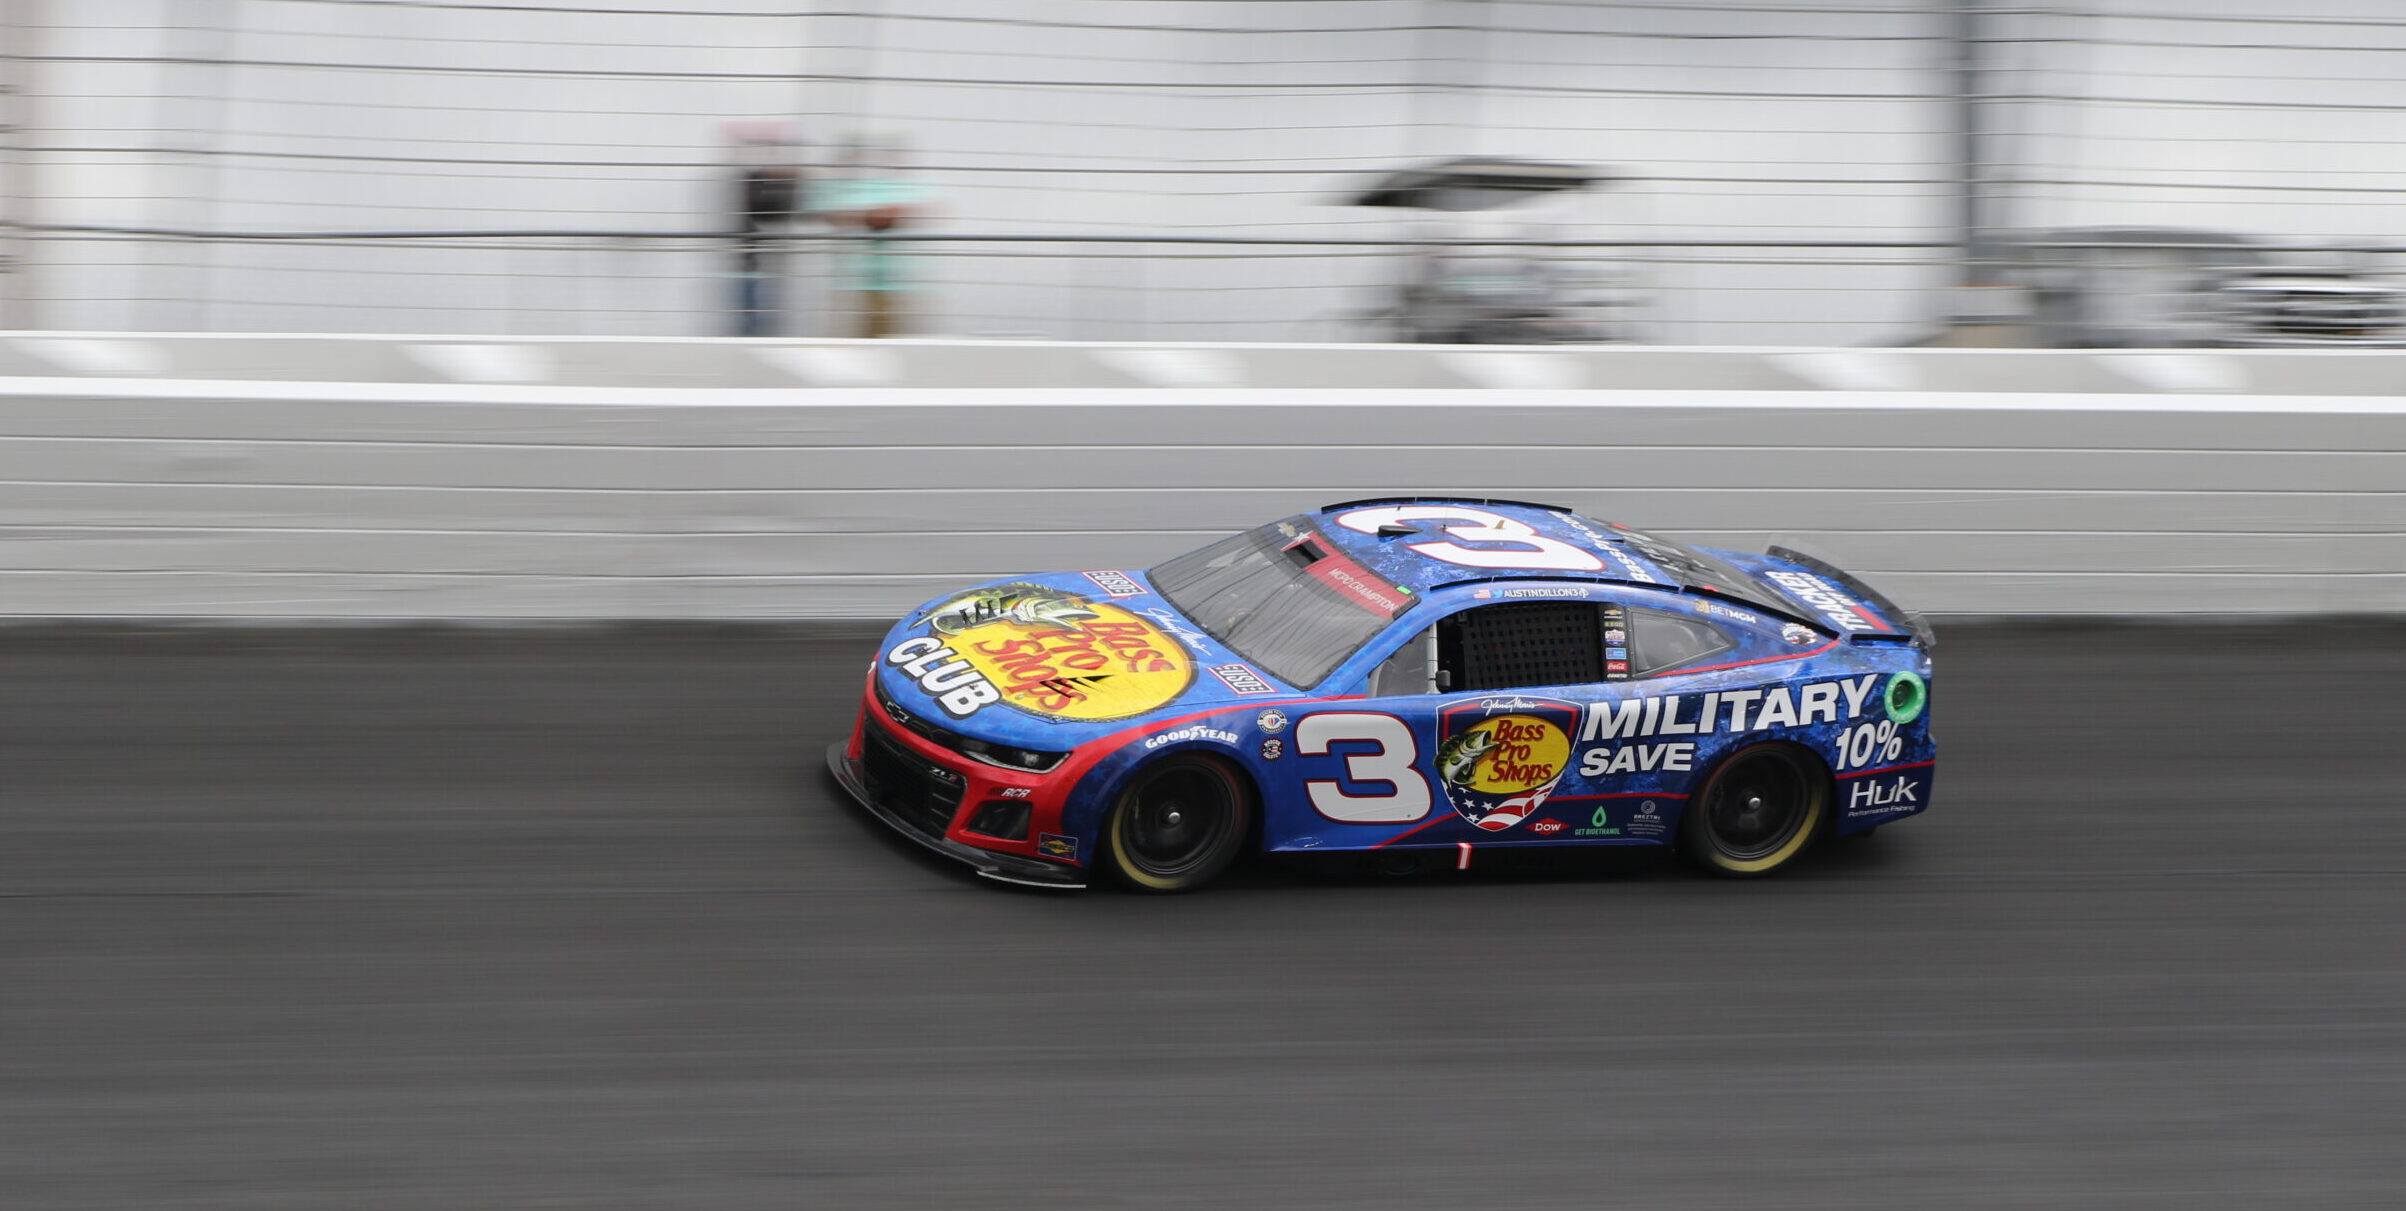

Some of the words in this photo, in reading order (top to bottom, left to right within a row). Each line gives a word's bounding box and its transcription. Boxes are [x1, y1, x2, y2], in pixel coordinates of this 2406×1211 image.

[1335, 505, 1607, 571] 3
[1097, 573, 1135, 591] USO
[1504, 588, 1578, 598] AUSTINDILLON3
[1765, 570, 1875, 631] TRACKER
[1710, 604, 1757, 624] BETMGM
[1029, 629, 1110, 671] Pro
[1078, 621, 1176, 673] Bass
[888, 636, 1002, 716] CLUB
[971, 639, 1088, 711] Shops
[1219, 668, 1259, 689] USO
[1581, 674, 1878, 742] MILITARY
[1144, 725, 1239, 749] GOODYEAR
[1491, 719, 1546, 742] Bass
[1489, 741, 1531, 762] Pro
[1579, 742, 1695, 777] SAVE
[1835, 719, 1903, 770] 10%
[1297, 712, 1434, 824] 3
[1487, 761, 1553, 787] Shops
[1848, 806, 1889, 817] Performance
[1890, 804, 1916, 812] Fishing
[1586, 828, 1621, 836] BIOETHANOL
